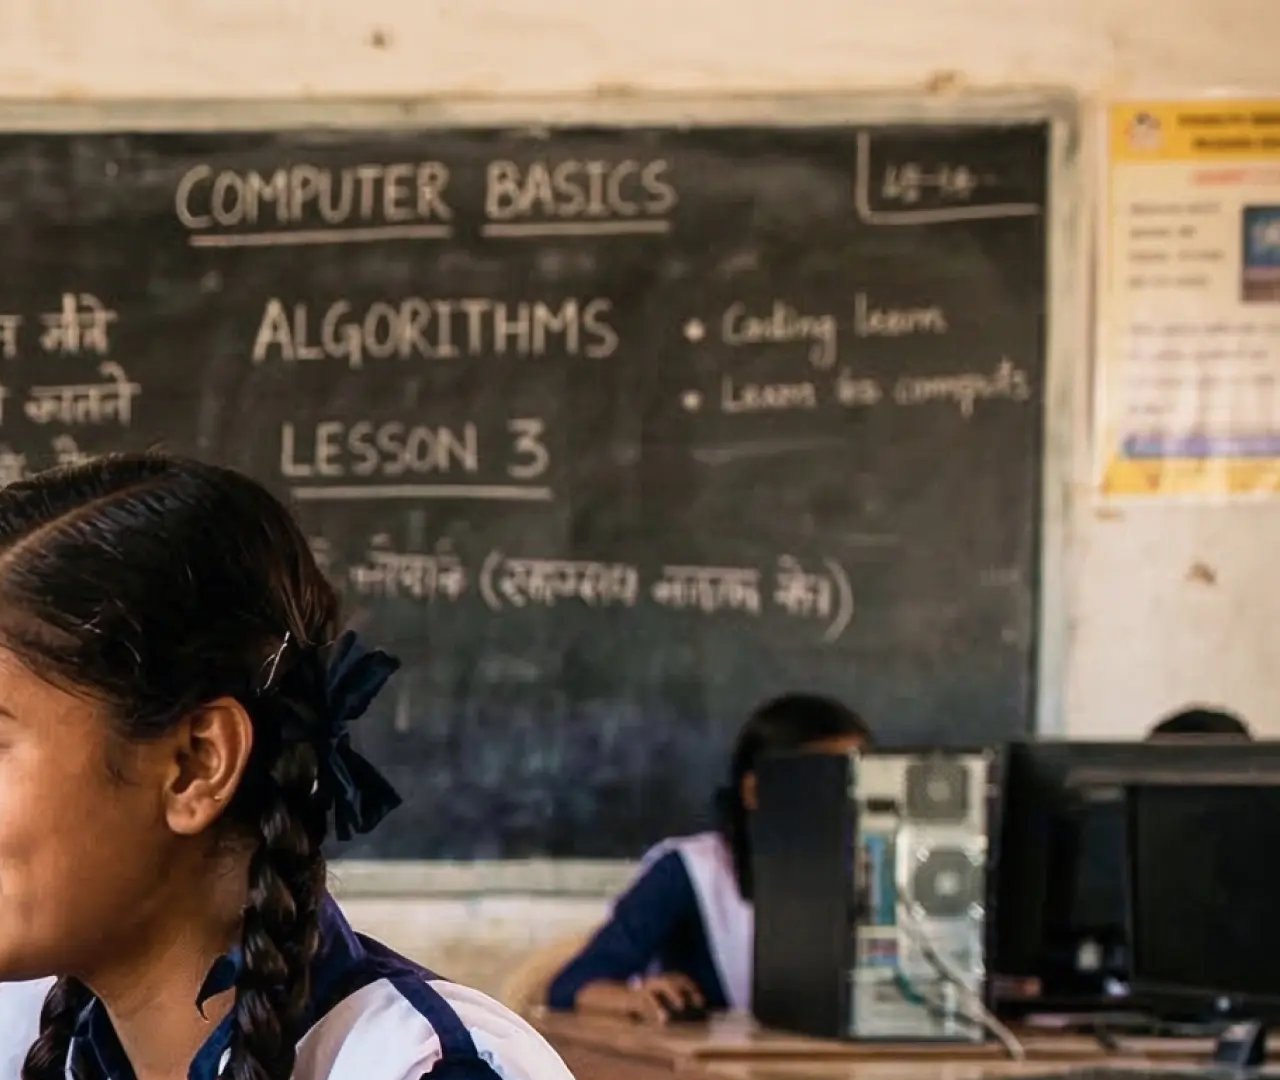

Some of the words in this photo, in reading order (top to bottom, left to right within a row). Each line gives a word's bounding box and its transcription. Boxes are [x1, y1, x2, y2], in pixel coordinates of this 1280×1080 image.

[176, 161, 454, 229] COMPUTER
[484, 158, 677, 219] BASICS
[251, 296, 620, 369] ALGORITHMS
[281, 420, 479, 478] LESSON
[507, 416, 551, 479] 3
